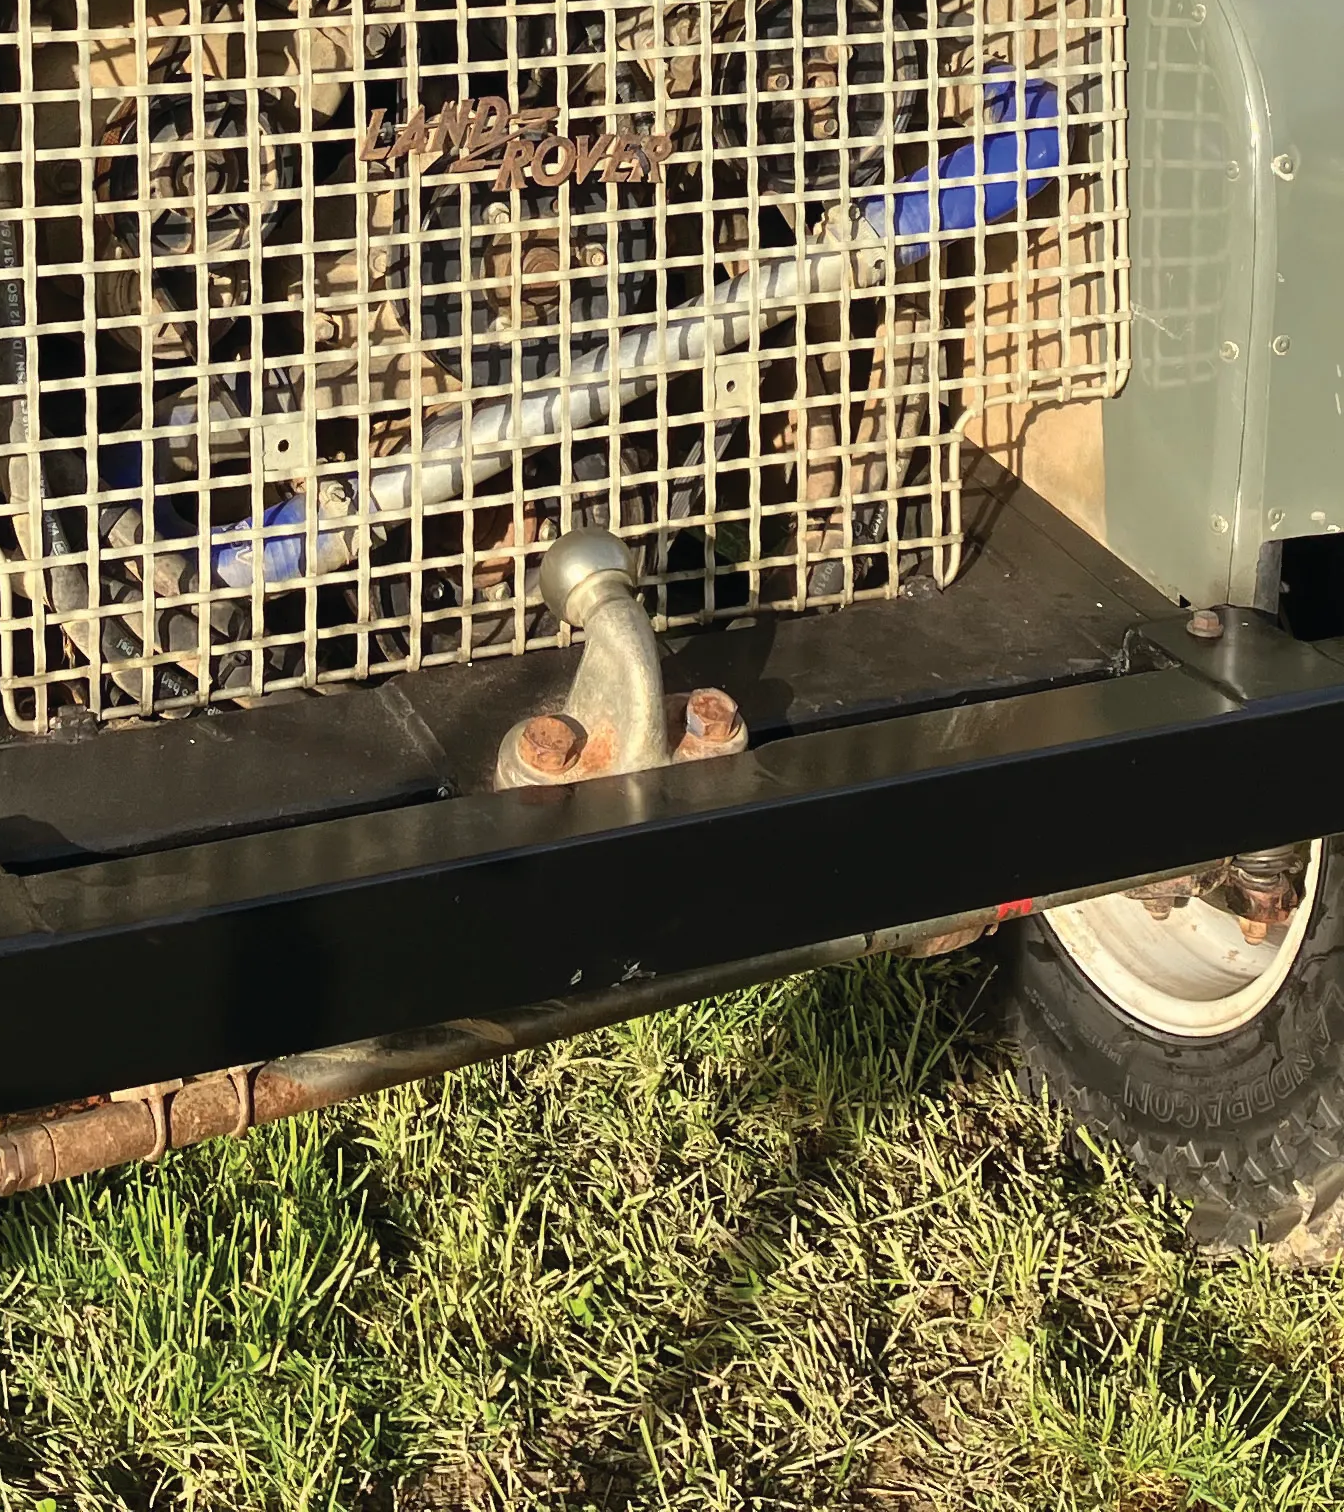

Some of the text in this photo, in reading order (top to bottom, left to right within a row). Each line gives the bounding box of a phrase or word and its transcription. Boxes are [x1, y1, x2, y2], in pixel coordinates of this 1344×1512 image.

[358, 95, 510, 162] LAND
[492, 131, 674, 192] ROVER
[7, 282, 20, 308] ISO
